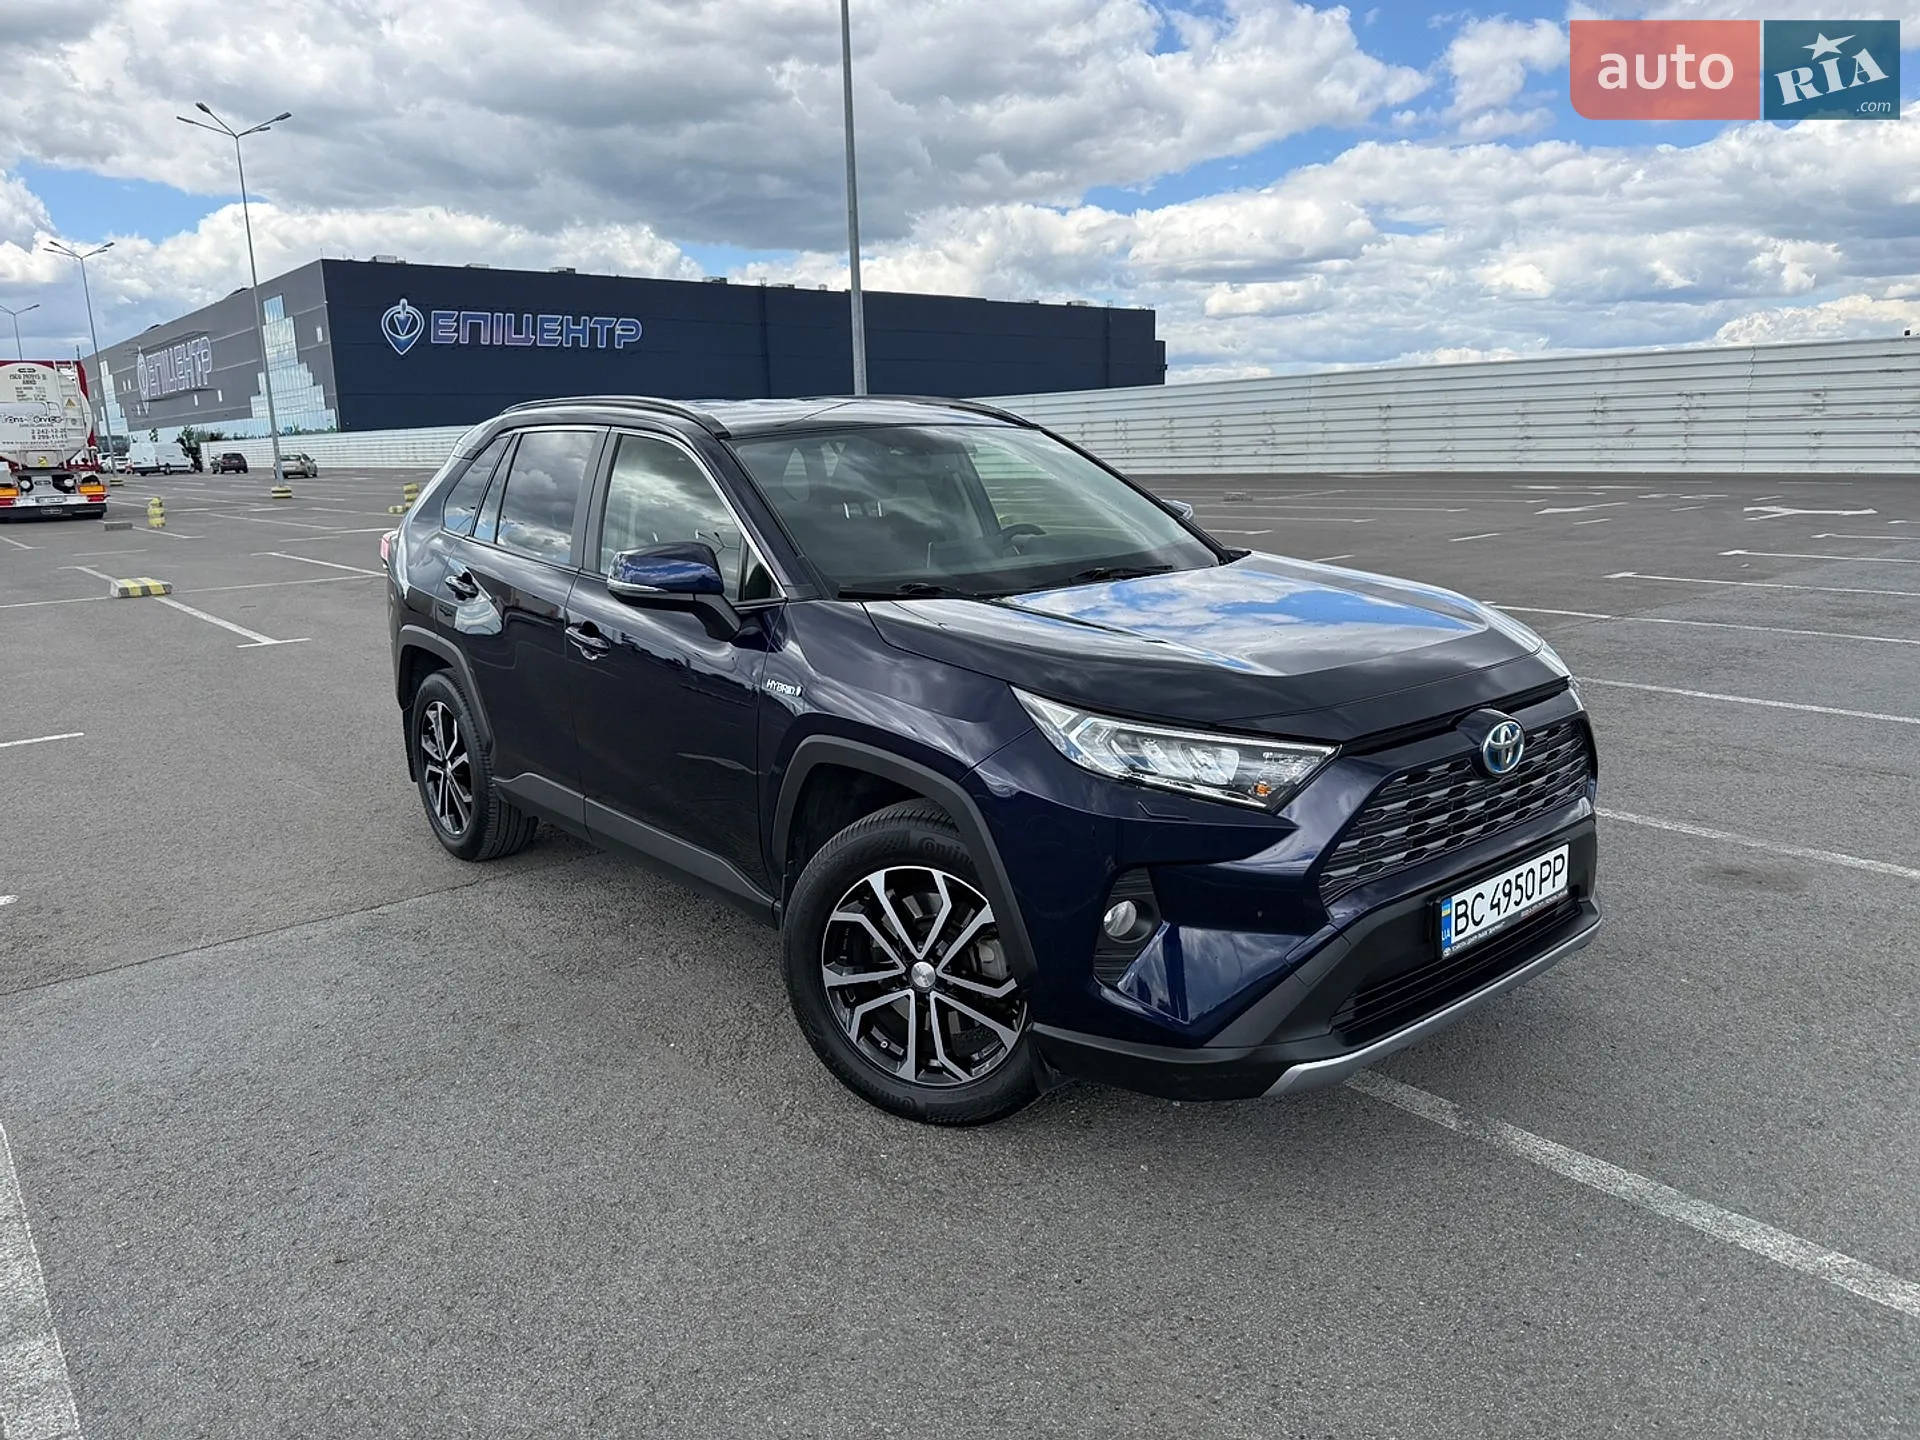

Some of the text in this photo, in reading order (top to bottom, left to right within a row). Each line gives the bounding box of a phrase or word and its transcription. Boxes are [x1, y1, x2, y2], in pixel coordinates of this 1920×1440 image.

[431, 310, 643, 349] ЕПІЦЕНТР
[766, 679, 796, 695] HYBRID
[1454, 892, 1485, 937] BC
[1490, 868, 1536, 917] 4950
[1538, 853, 1565, 895] PP
